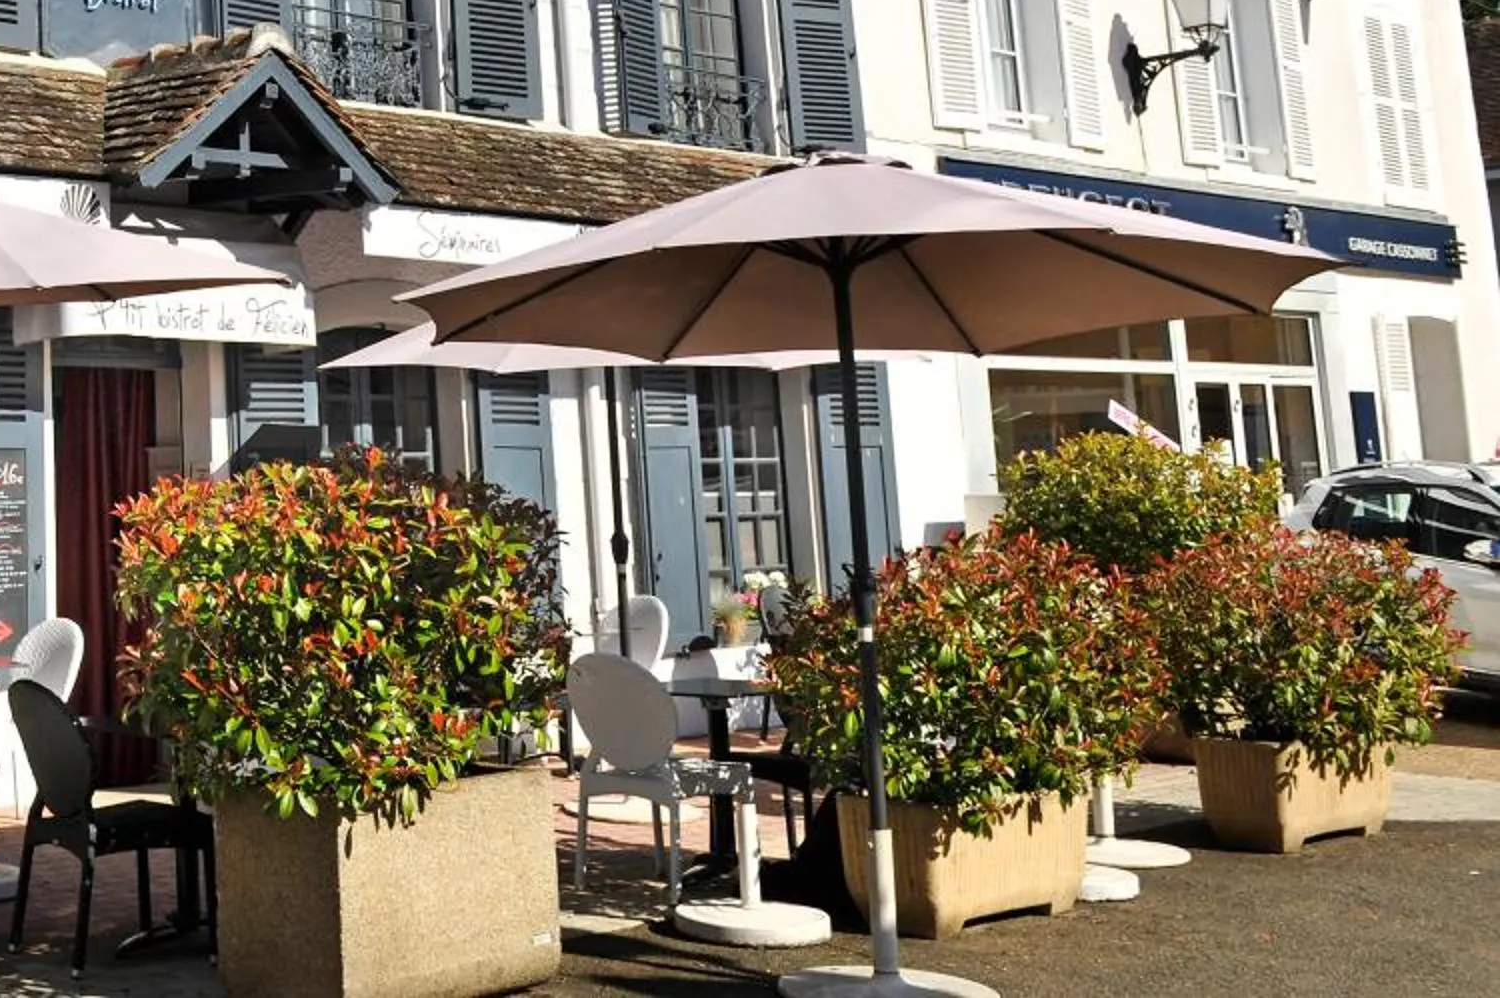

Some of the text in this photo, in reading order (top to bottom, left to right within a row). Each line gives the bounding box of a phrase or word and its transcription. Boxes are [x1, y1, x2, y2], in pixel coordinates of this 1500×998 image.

[417, 209, 501, 258] Séminaires
[155, 302, 210, 332] bistrot
[217, 303, 236, 332] de
[245, 297, 309, 339] Félicien
